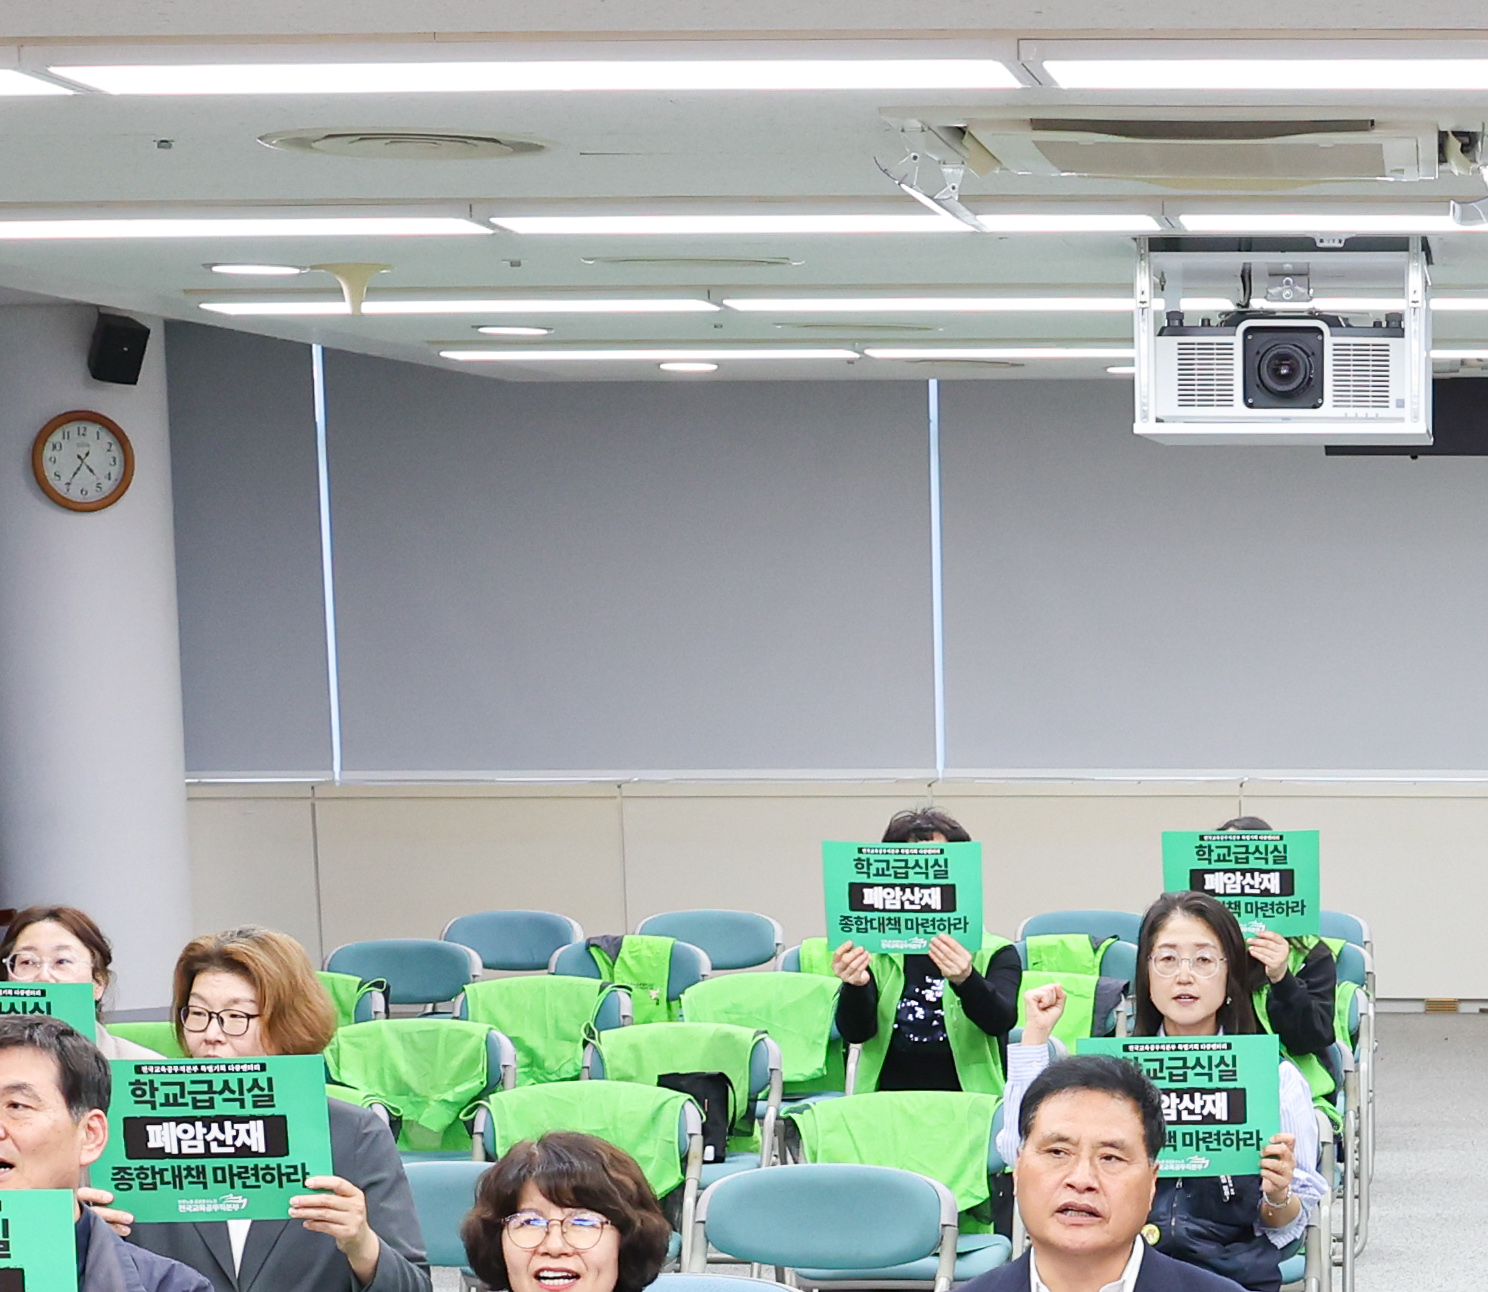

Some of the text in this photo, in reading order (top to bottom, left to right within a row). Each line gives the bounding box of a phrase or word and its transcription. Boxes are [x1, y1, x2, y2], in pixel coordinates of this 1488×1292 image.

[1193, 843, 1287, 864] 학교급식실
[852, 857, 948, 879] 학교급식실
[1204, 871, 1279, 893] 폐암산재
[863, 886, 940, 909] 폐암산재
[1244, 900, 1306, 918] 마련하라
[837, 915, 969, 935] 종합대책 마련하라
[127, 1076, 275, 1110] 학교급식실
[1156, 1092, 1227, 1120] 암산재
[146, 1120, 265, 1154] 폐암산재
[1181, 1129, 1263, 1152] 마련하라
[110, 1162, 310, 1191] 종합대책 마련하라
